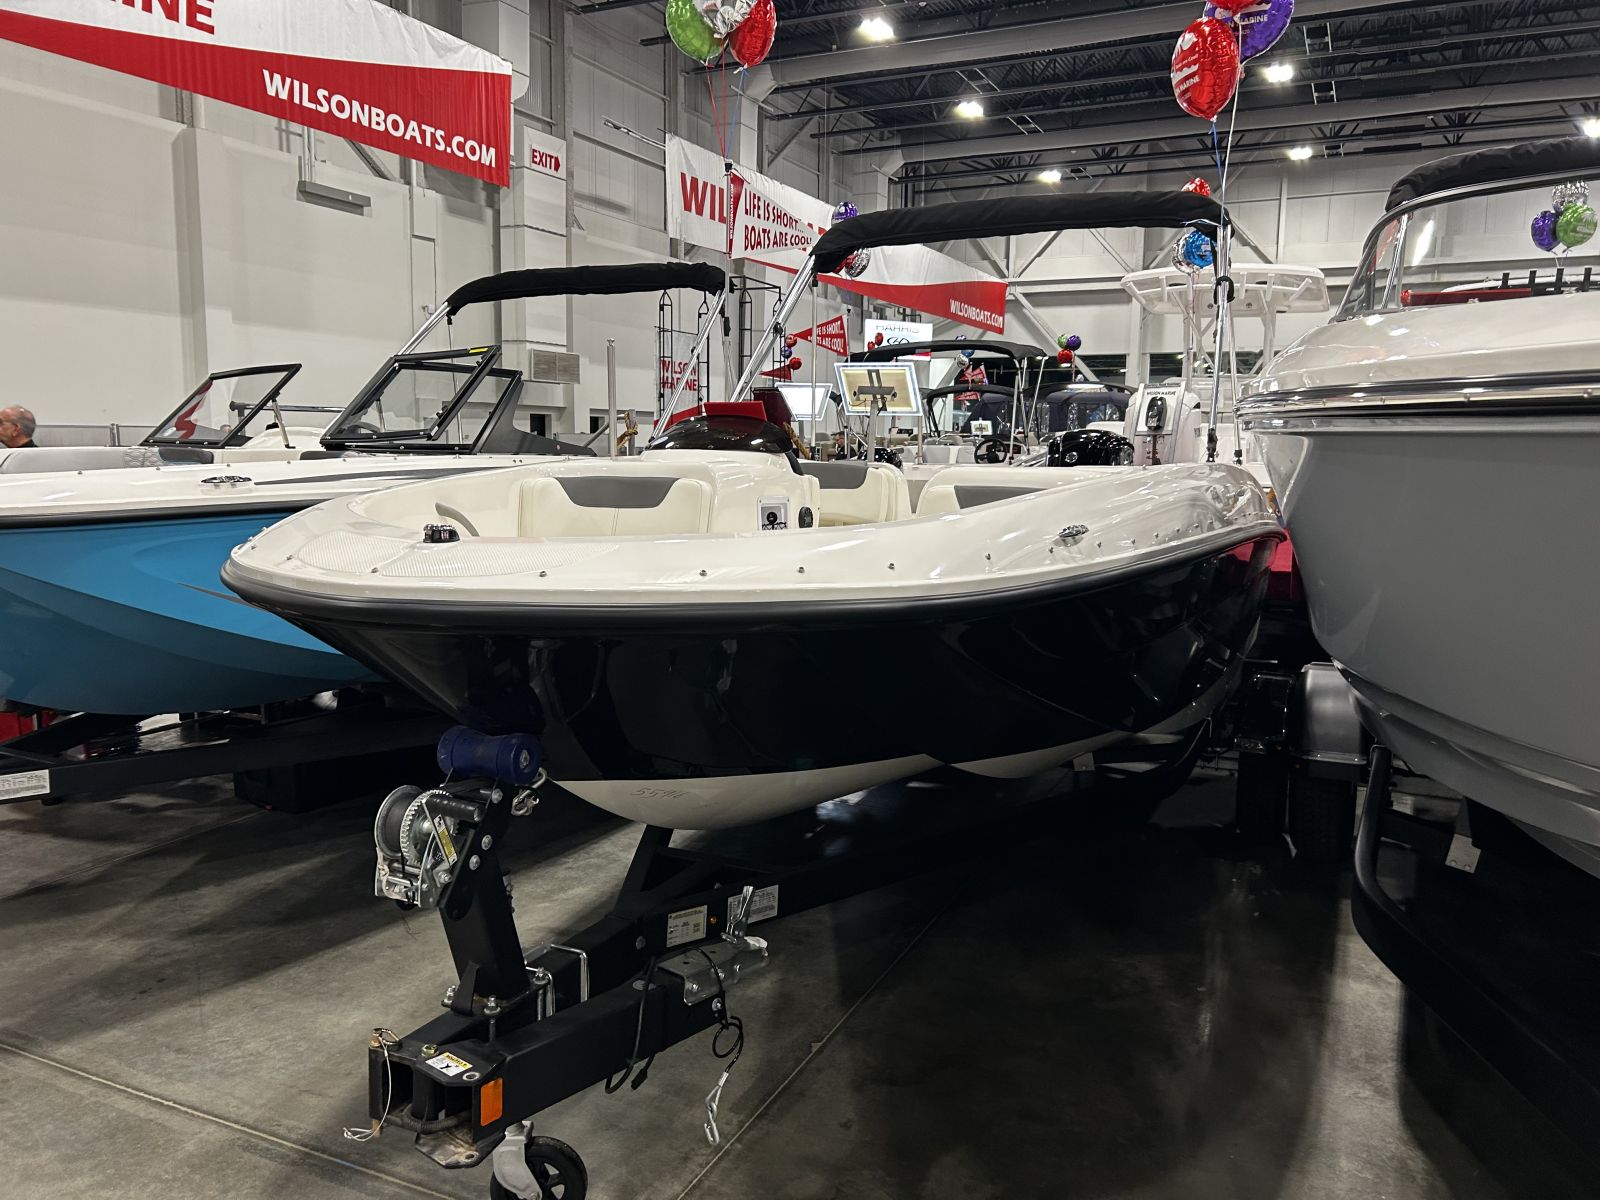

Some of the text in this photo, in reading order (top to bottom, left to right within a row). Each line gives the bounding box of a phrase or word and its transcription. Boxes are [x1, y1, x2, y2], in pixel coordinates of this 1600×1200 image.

[263, 68, 496, 168] WILSONBOATS.COM
[532, 148, 554, 170] EXIT
[744, 188, 761, 219] LIFE
[763, 200, 771, 222] IS
[744, 224, 812, 251] BOATS ARE COOL!
[950, 298, 1003, 328] WILSONBOATS.COM
[822, 325, 827, 335] IS
[822, 337, 831, 348] ARE
[661, 360, 697, 376] WLSN
[661, 376, 698, 392] MARNE
